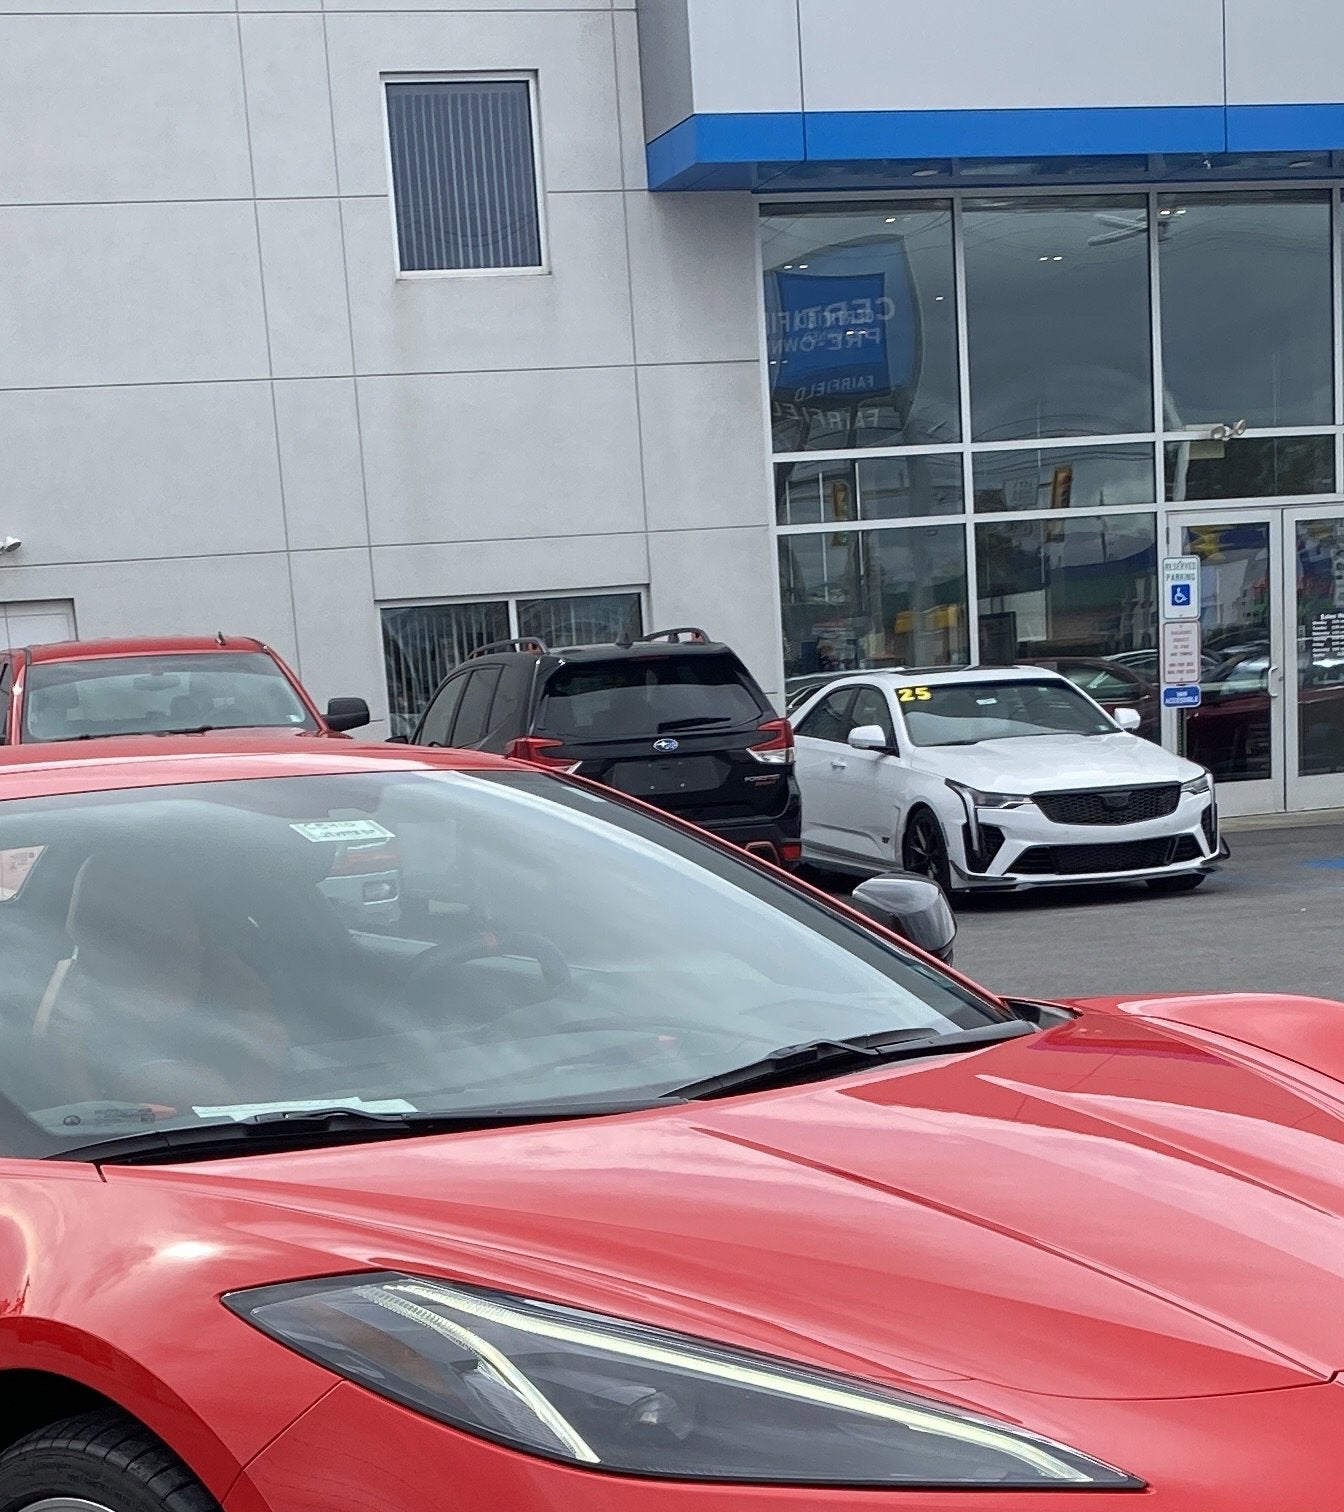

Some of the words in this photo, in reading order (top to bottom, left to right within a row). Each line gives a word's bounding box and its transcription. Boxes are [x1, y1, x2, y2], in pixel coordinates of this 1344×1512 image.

[1164, 562, 1197, 571] RESERVED
[1166, 573, 1196, 582] PARKING
[898, 687, 932, 702] 25
